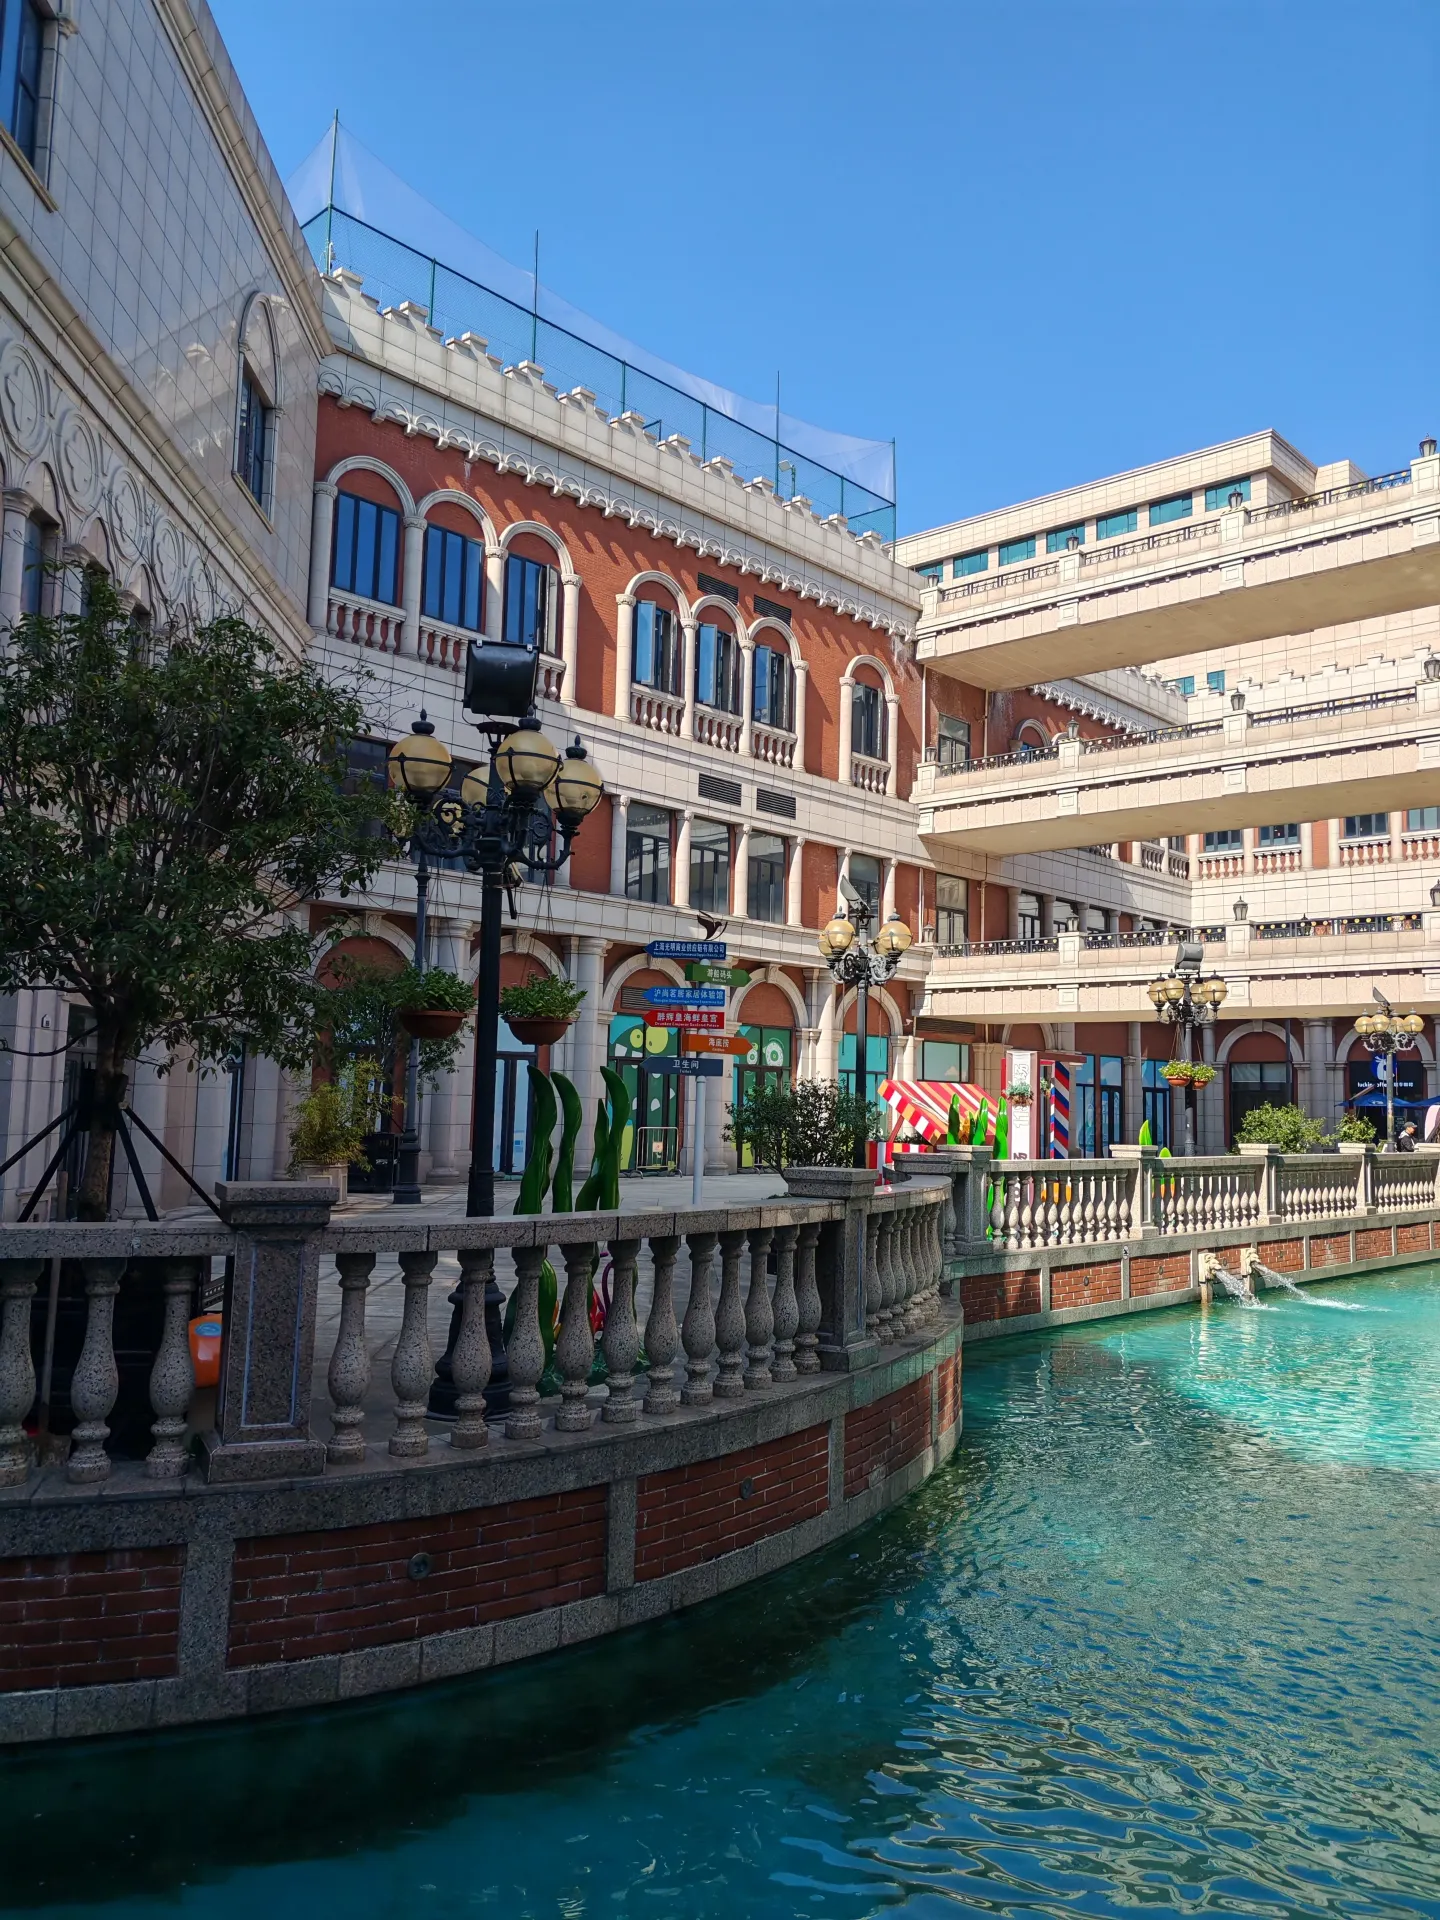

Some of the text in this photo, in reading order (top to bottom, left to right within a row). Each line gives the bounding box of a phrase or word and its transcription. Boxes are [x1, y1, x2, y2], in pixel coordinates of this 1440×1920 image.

[707, 968, 732, 979] 游船码头
[654, 989, 724, 1000] 沪尚茗居家居体验馆
[709, 1037, 729, 1048] 海底捞
[672, 1059, 699, 1069] 卫生间
